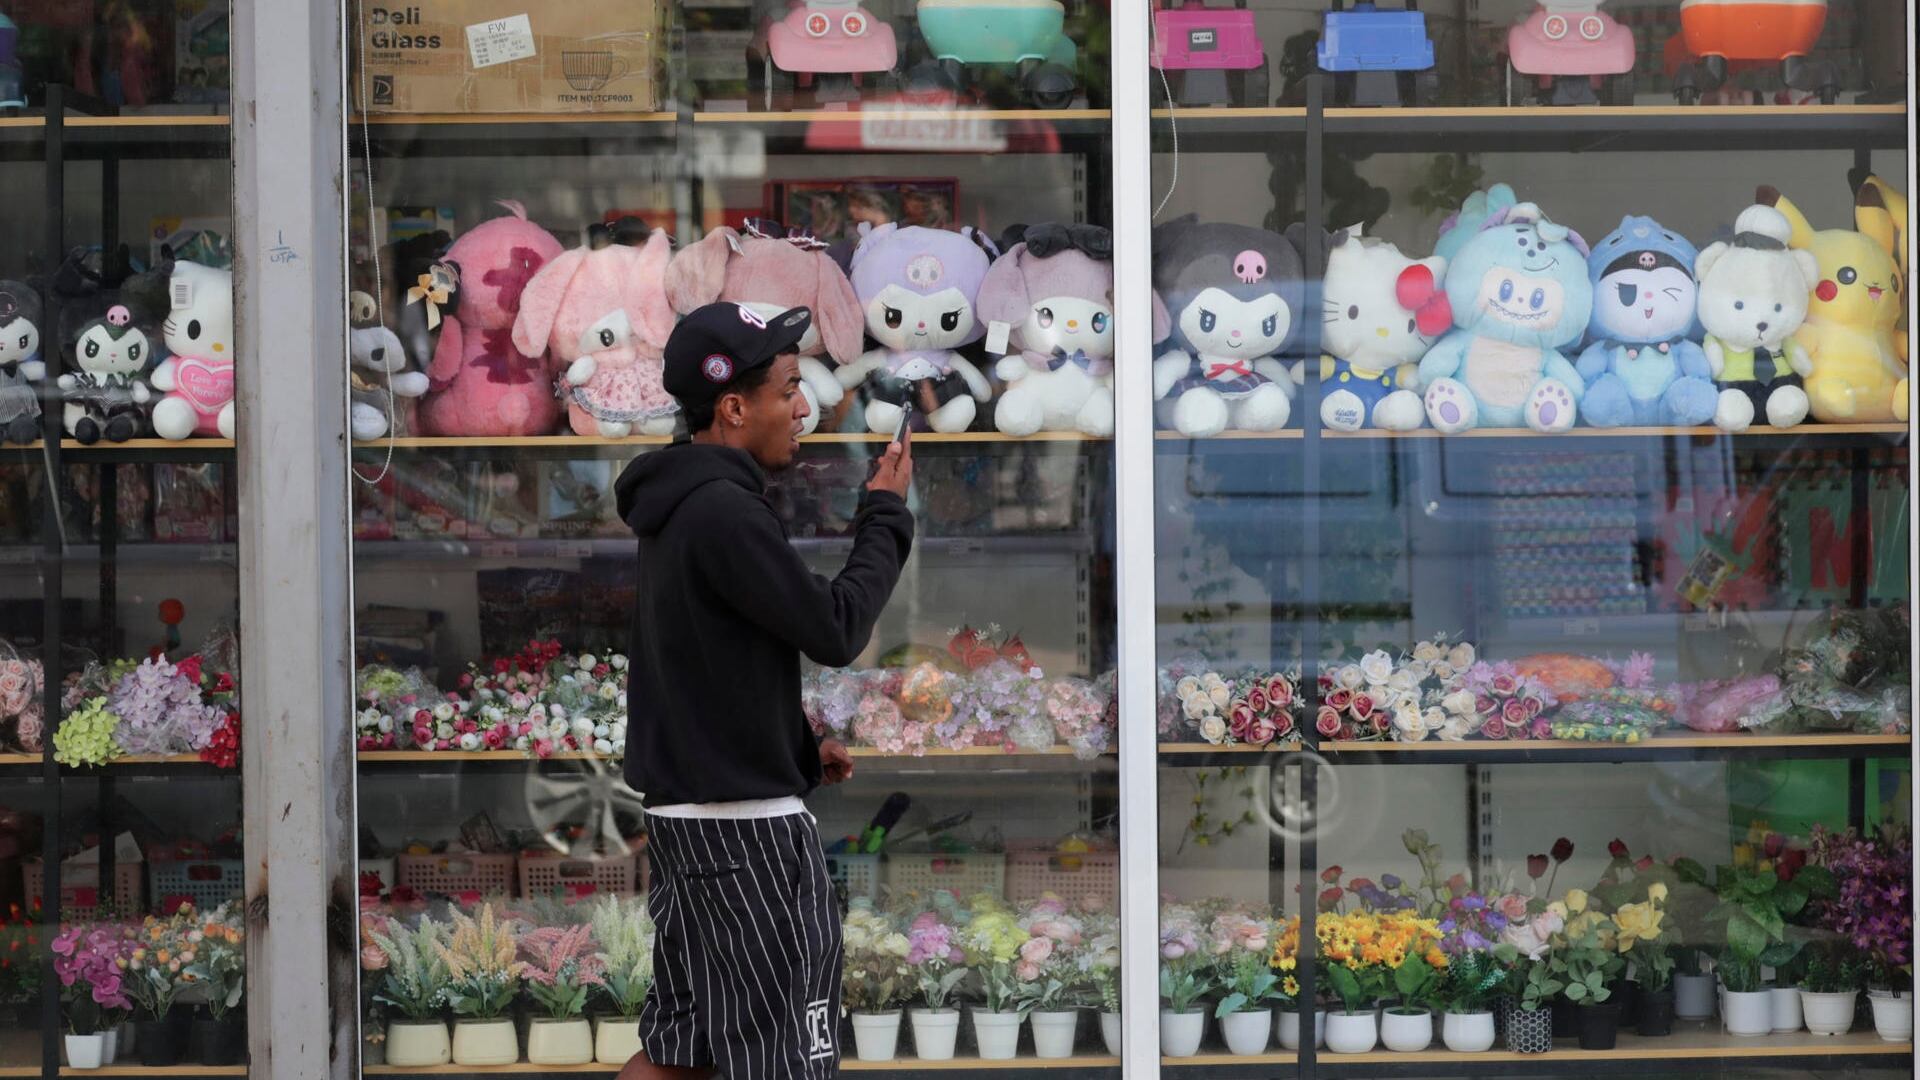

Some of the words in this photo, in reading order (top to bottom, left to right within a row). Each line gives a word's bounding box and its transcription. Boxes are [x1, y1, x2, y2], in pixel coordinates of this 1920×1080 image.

[372, 7, 420, 25] Deli
[487, 21, 506, 34] FW
[371, 31, 441, 49] Glass
[558, 95, 578, 103] ITEM
